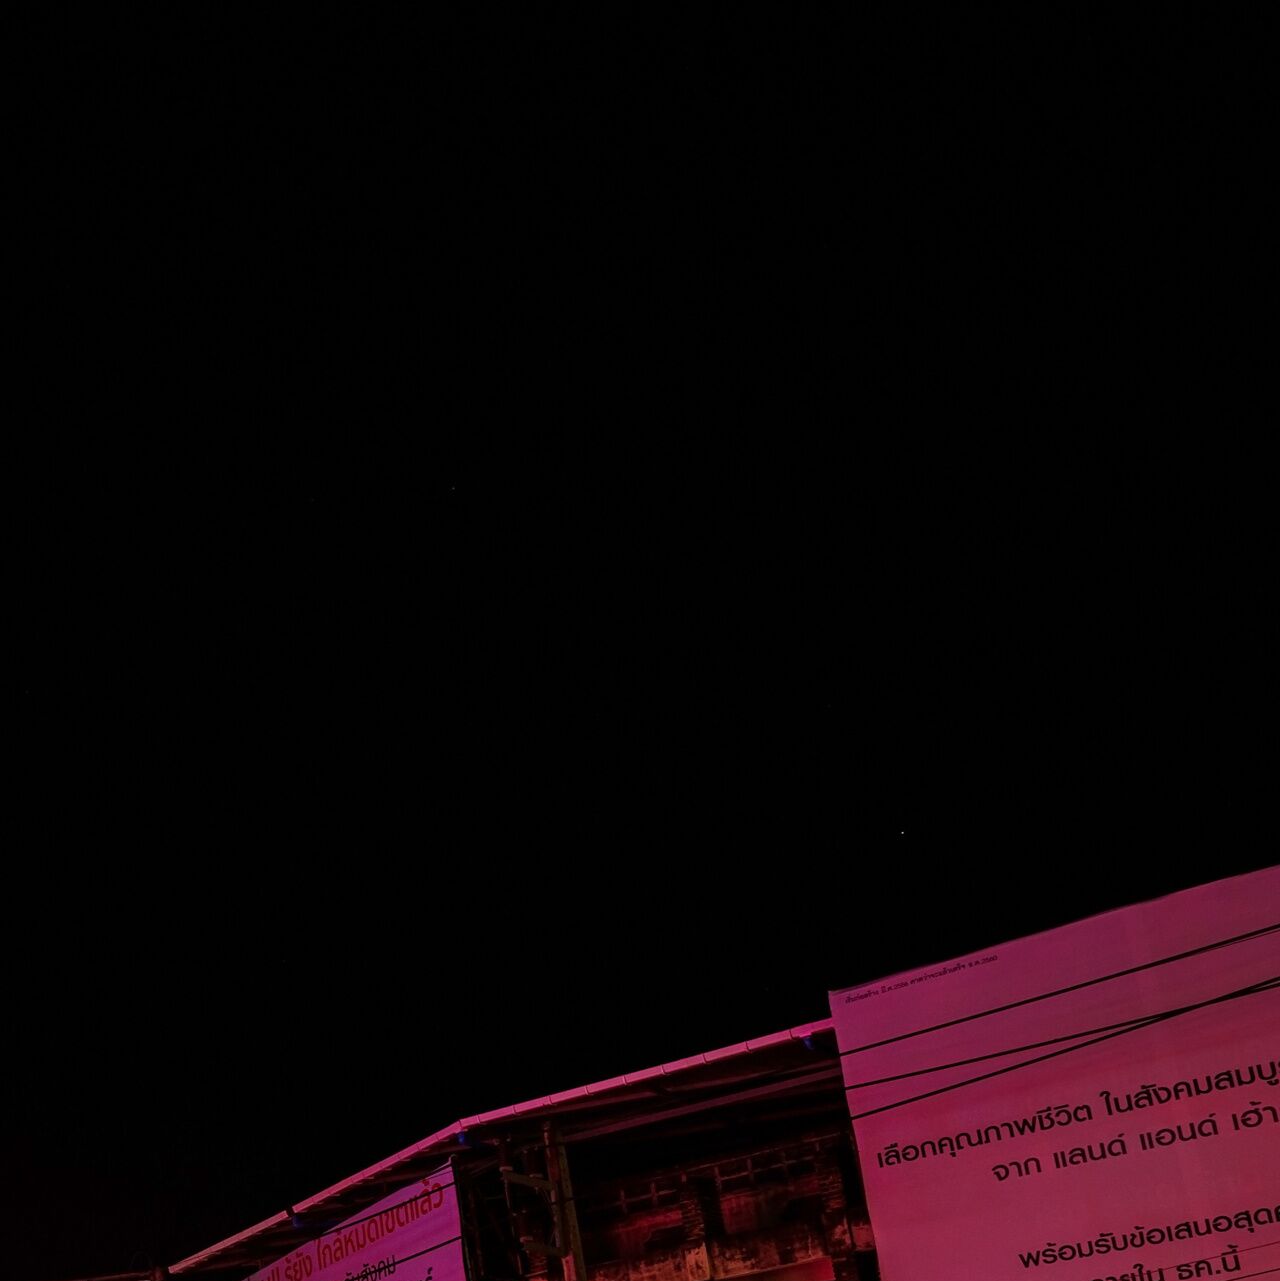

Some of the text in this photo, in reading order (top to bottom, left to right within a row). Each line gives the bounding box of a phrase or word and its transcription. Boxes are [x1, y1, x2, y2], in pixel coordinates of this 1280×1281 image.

[877, 1060, 1280, 1168] เลือกคุณภาพชีวิต ในสังคมสมบู
[991, 1158, 1042, 1182] จาก
[1053, 1134, 1128, 1169] แลนด์
[1140, 1113, 1219, 1151] แอนด์
